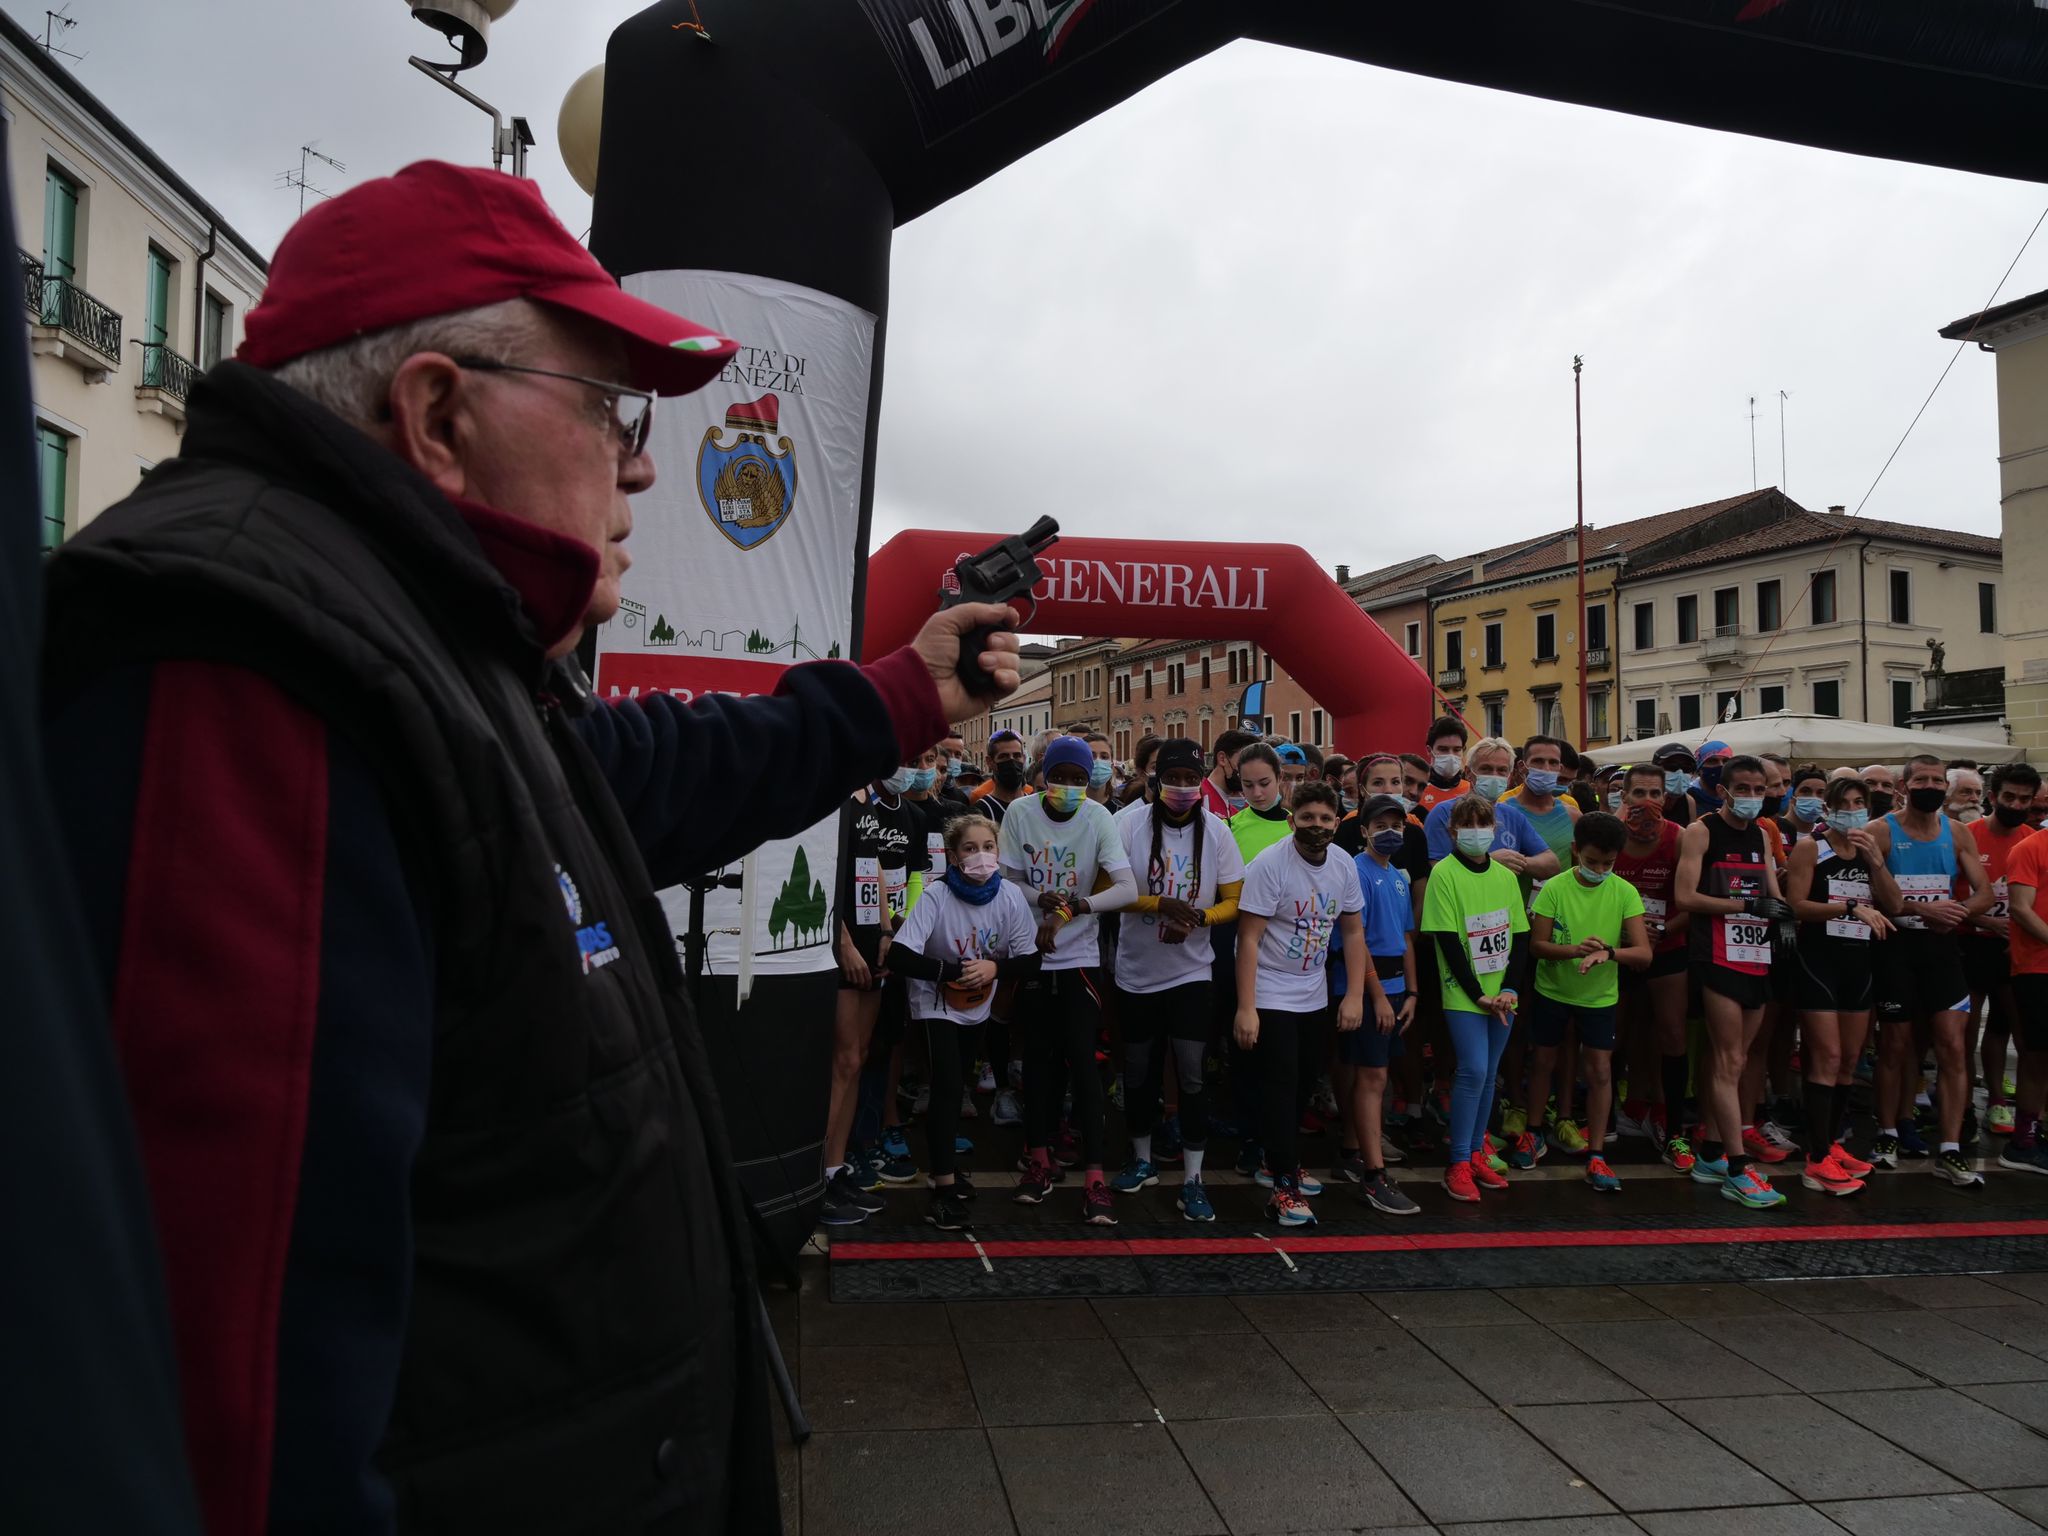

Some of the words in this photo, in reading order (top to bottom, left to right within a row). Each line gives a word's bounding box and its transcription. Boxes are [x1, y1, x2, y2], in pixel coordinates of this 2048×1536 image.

[784, 354, 807, 376] DI
[718, 364, 803, 395] ENEZIA
[1031, 557, 1269, 610] GENERALI
[1031, 840, 1076, 868] viva
[1030, 863, 1077, 890] pira
[1295, 888, 1336, 916] viva
[955, 926, 998, 956] viva
[1480, 931, 1507, 955] 465
[1732, 925, 1763, 945] 398
